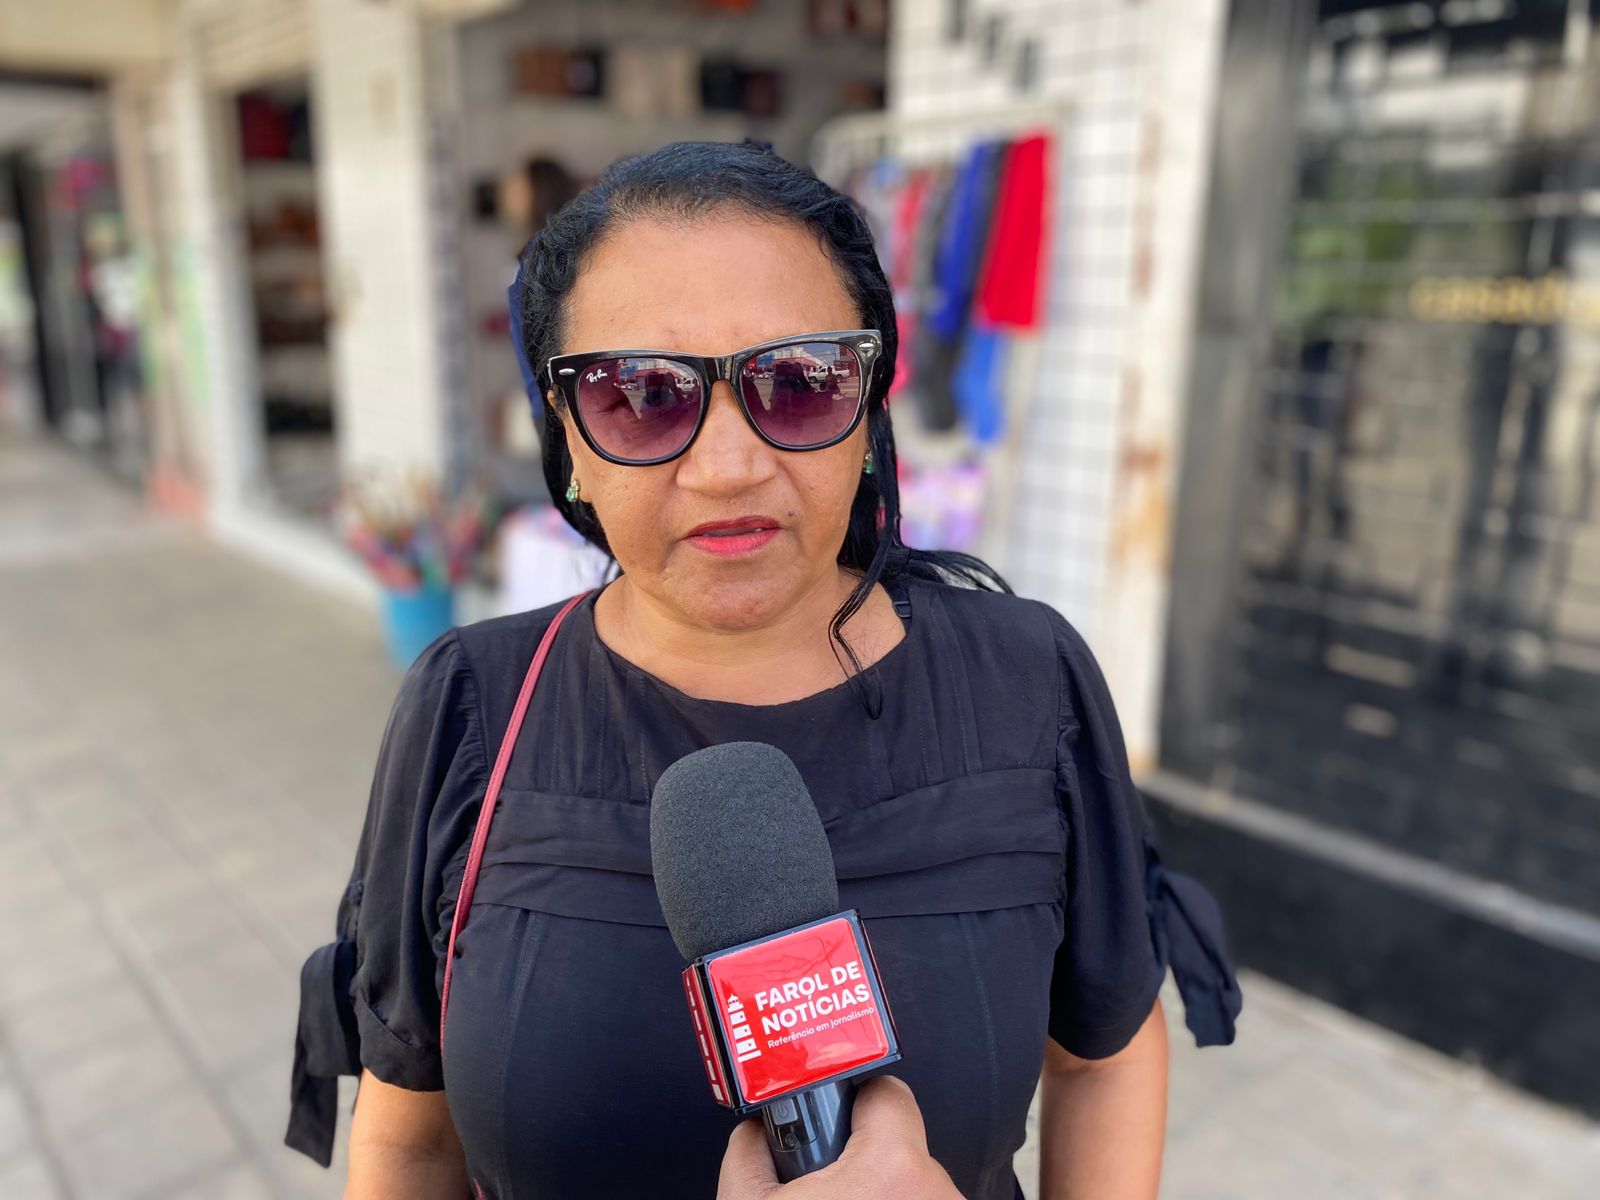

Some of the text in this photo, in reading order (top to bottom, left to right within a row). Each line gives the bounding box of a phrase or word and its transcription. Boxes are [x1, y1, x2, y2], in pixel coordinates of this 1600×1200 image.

[755, 961, 861, 1011] FAROL DE
[761, 983, 870, 1035] NOTÍCIAS
[768, 1027, 815, 1048] Referência
[815, 1021, 830, 1032] em
